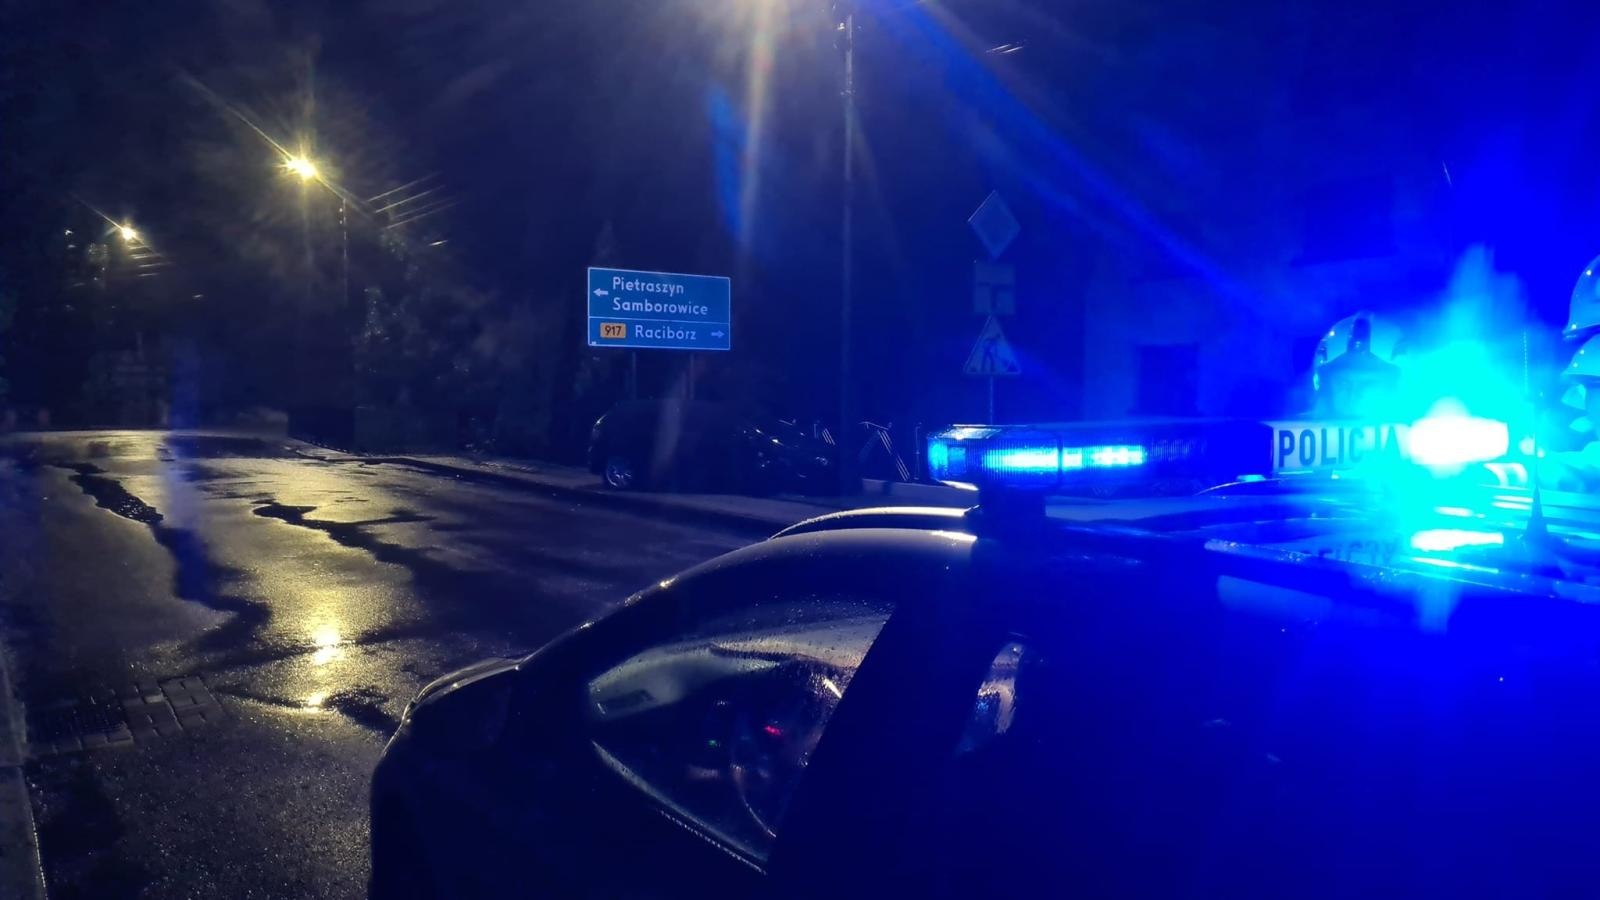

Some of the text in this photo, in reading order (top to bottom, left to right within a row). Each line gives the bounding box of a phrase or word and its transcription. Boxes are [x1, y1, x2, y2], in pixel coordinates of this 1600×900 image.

[612, 276, 685, 297] Pietraszyn
[612, 297, 708, 315] Samborowice
[604, 325, 622, 337] 917
[635, 324, 697, 340] Racibórz
